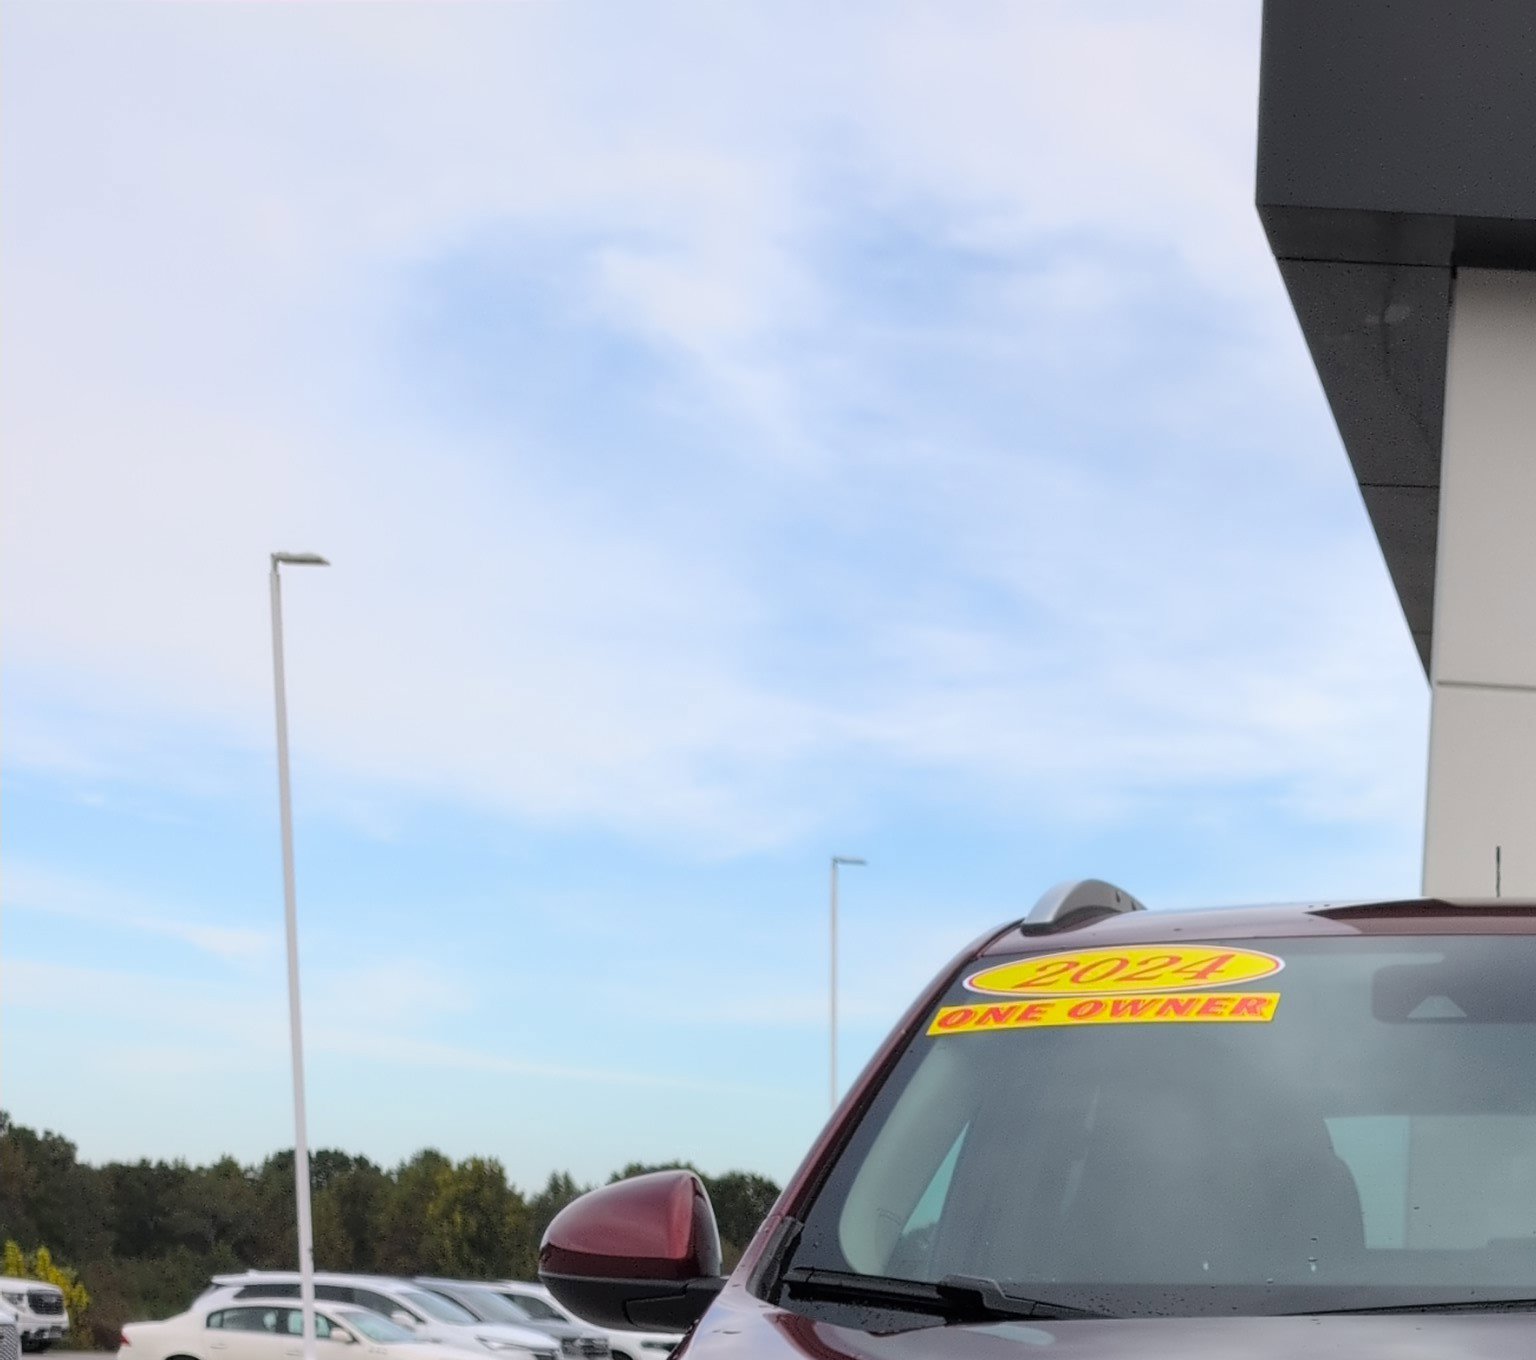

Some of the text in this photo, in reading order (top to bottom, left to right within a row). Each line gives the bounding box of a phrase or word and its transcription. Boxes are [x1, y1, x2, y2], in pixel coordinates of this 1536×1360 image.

[1012, 953, 1236, 990] 2024
[938, 996, 1271, 1030] ONE OWNER
